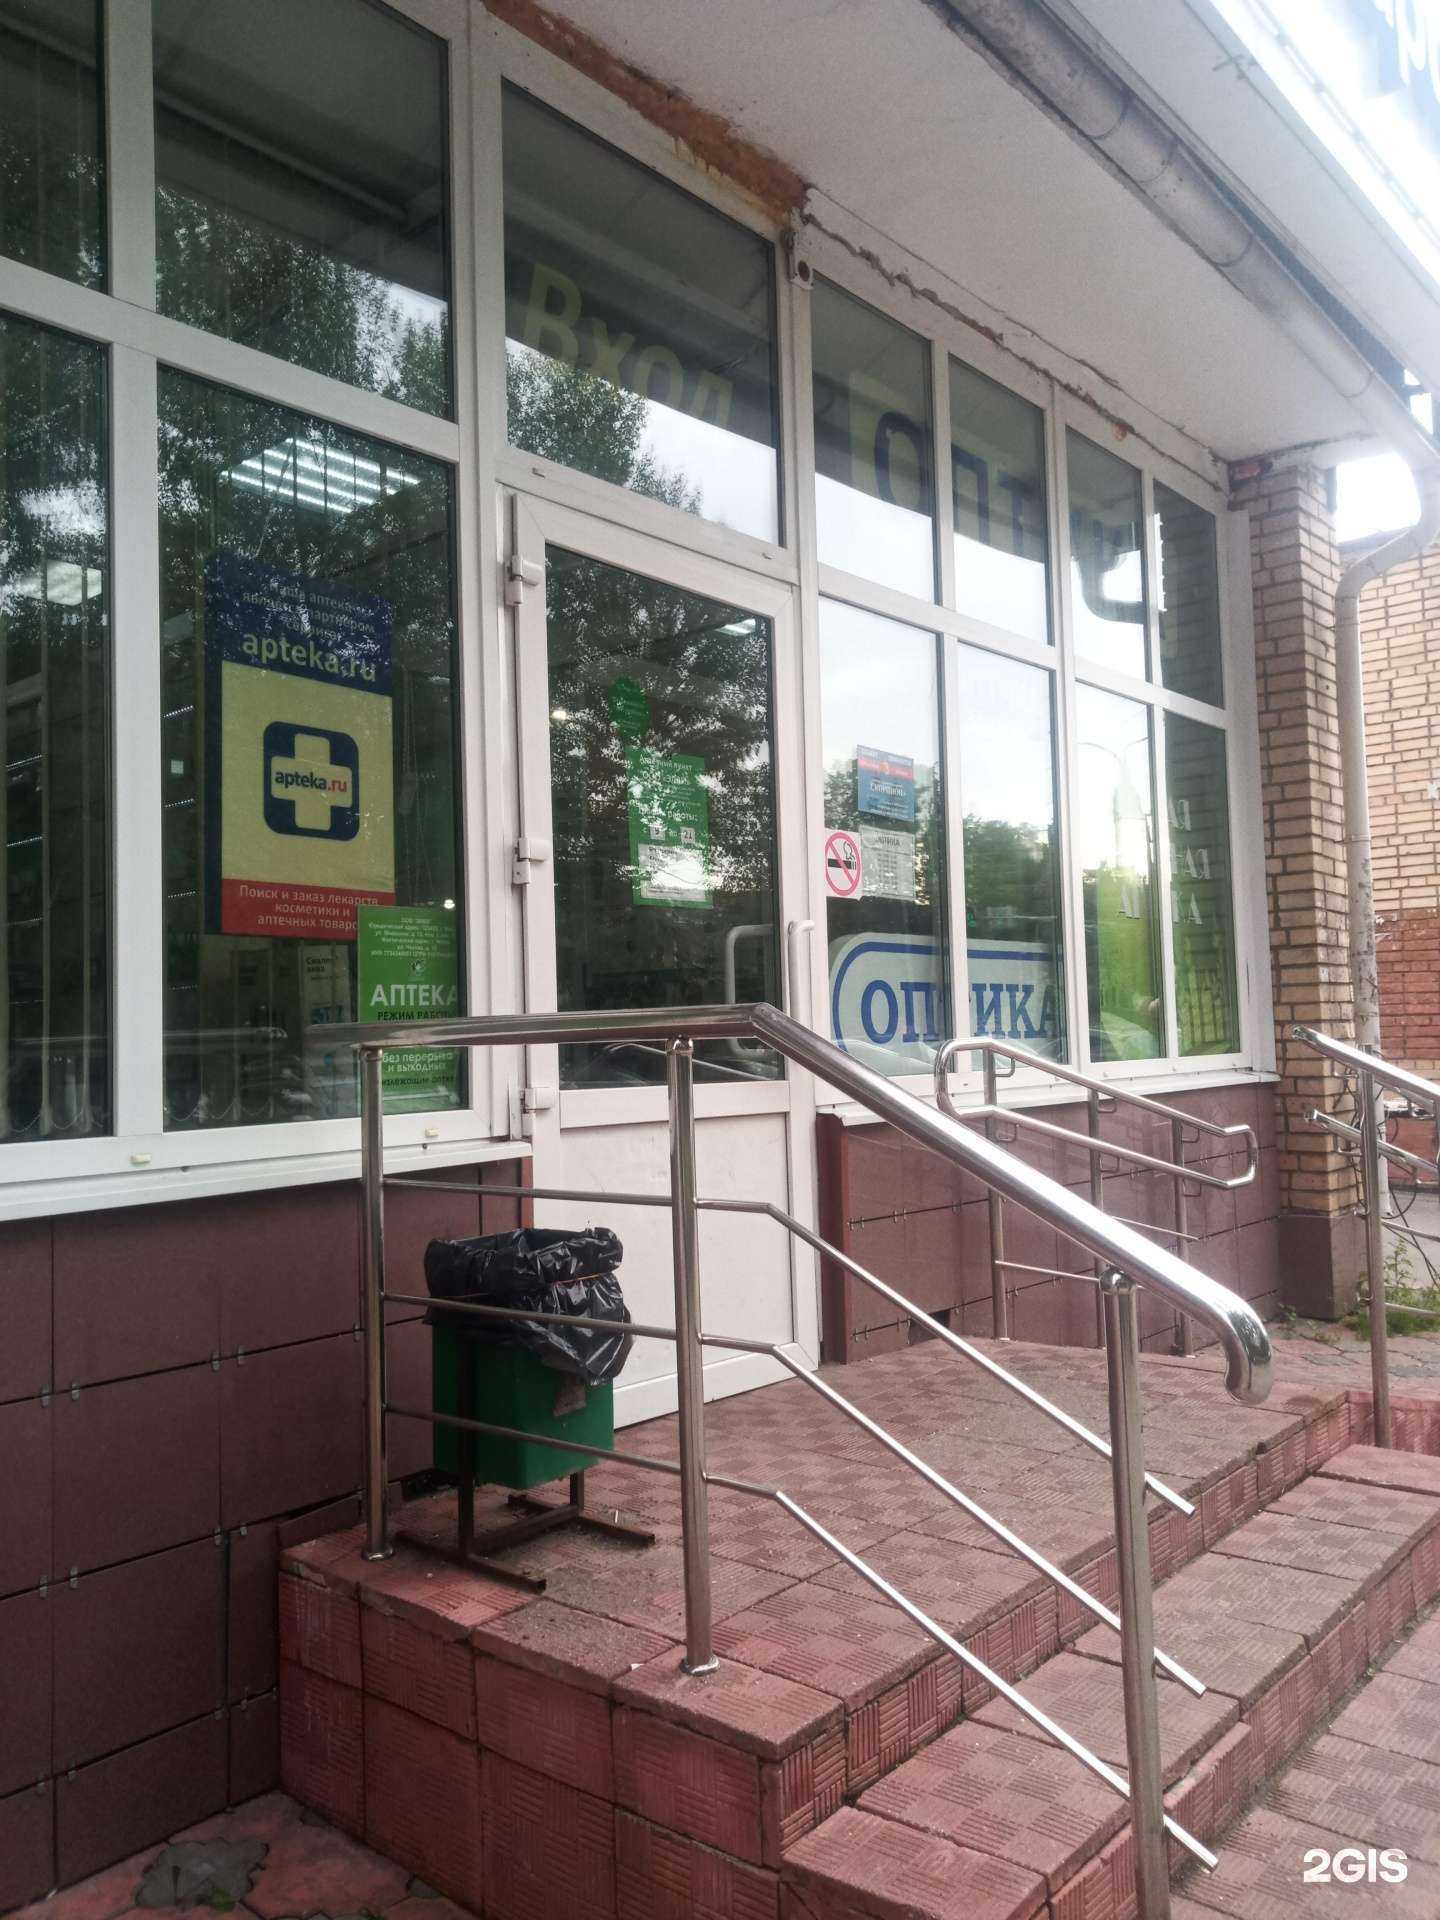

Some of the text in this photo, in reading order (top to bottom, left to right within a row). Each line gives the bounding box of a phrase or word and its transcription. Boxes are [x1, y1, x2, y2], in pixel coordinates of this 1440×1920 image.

[242, 632, 376, 682] apteka.ru
[275, 771, 347, 793] apteka.ru
[239, 885, 278, 899] Поиск
[281, 892, 289, 900] и
[293, 892, 325, 903] заказ
[275, 903, 340, 917] косметики
[258, 914, 316, 928] аптечных
[378, 1011, 415, 1021] РЕЖИМ
[860, 978, 1062, 1045] ОПИКА
